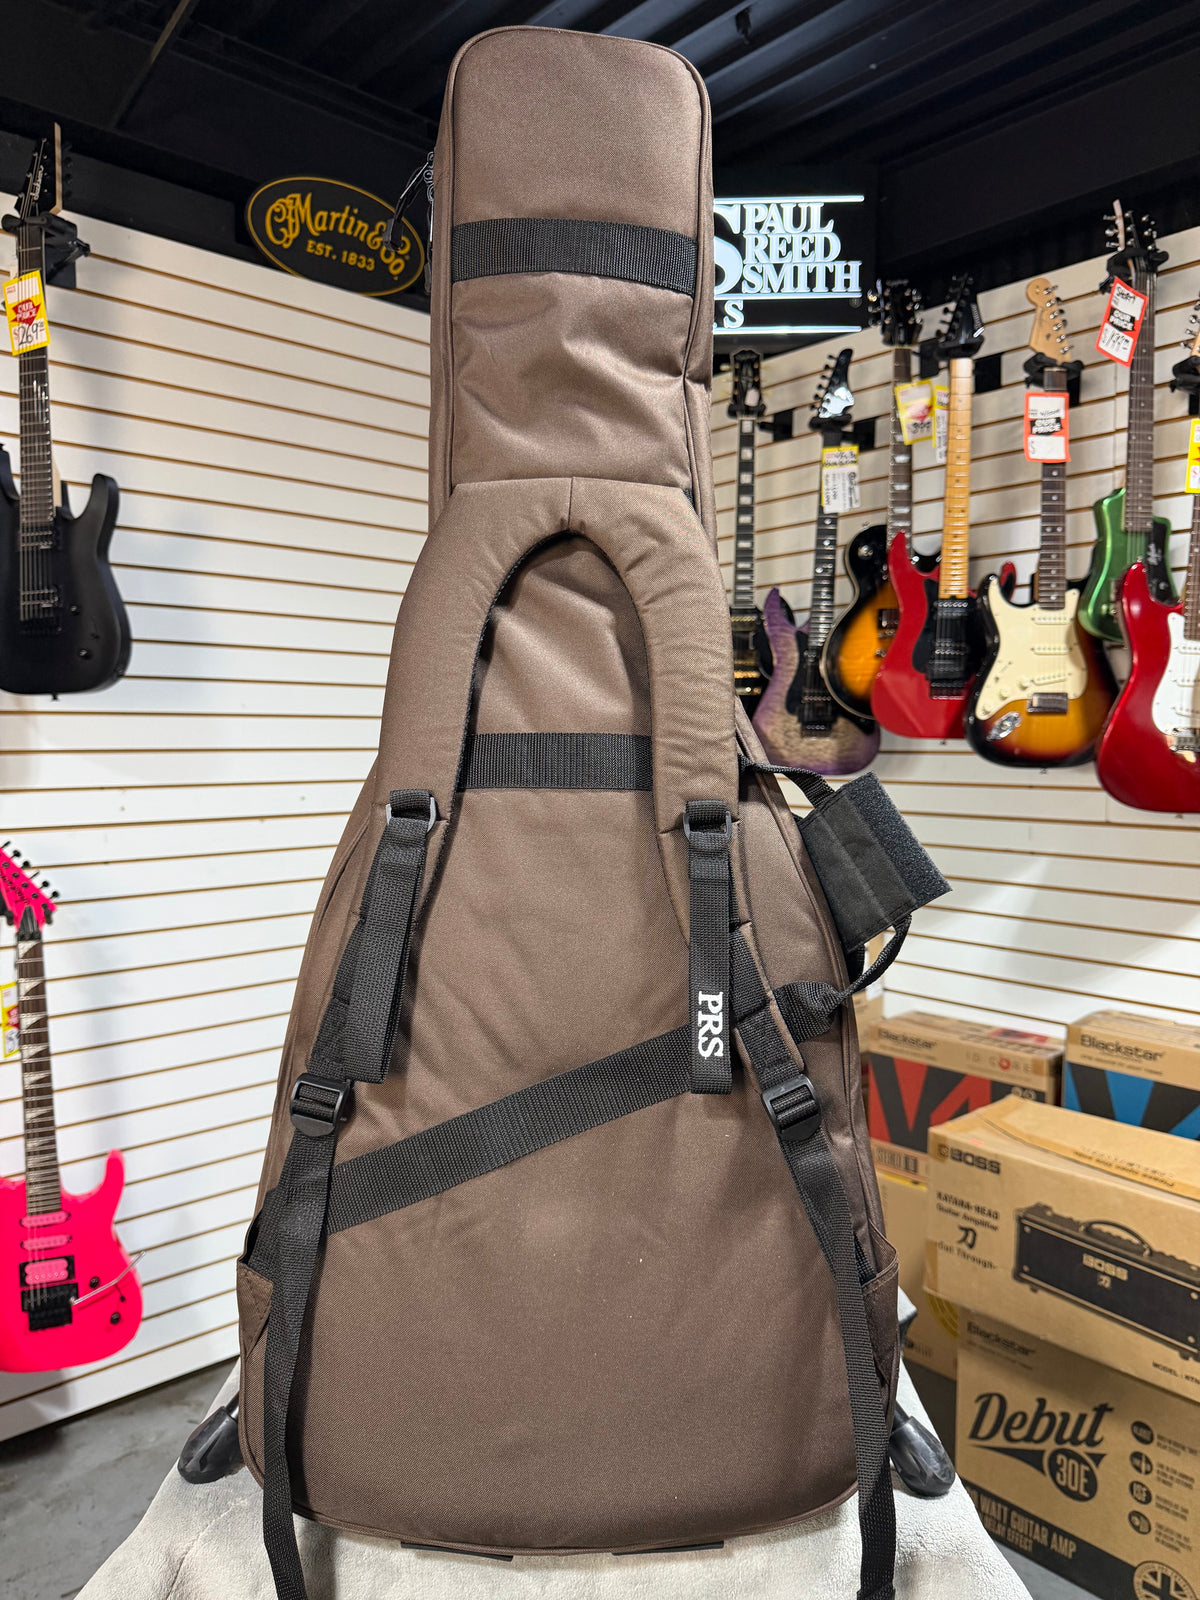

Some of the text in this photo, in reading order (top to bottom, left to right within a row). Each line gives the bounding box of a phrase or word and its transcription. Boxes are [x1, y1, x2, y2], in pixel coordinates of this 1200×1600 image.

[743, 203, 835, 234] PAUL
[306, 240, 376, 271] EST. 1833
[743, 232, 841, 264] REED
[742, 261, 862, 294] SMITH
[16, 308, 37, 322] PRICE
[17, 302, 34, 314] OUR
[1113, 309, 1132, 321] OUR
[1109, 315, 1134, 331] PRICE
[1032, 423, 1061, 435] PRICE
[1035, 418, 1057, 428] OUR
[697, 990, 724, 1059] PRS
[878, 1029, 938, 1049] Blackstar
[1080, 1033, 1165, 1061] Blackstar
[949, 1147, 1002, 1175] BOSS
[936, 1202, 999, 1232] Guitar Amplifier
[957, 1225, 977, 1249] 刀
[1082, 1253, 1129, 1282] BOSS
[968, 1392, 1115, 1448] Debut
[1054, 1455, 1092, 1500] 30E
[980, 1494, 1009, 1525] WATT
[1010, 1510, 1049, 1547] GUITAR
[1050, 1532, 1078, 1560] AMP
[1006, 1528, 1034, 1553] EFFECT
